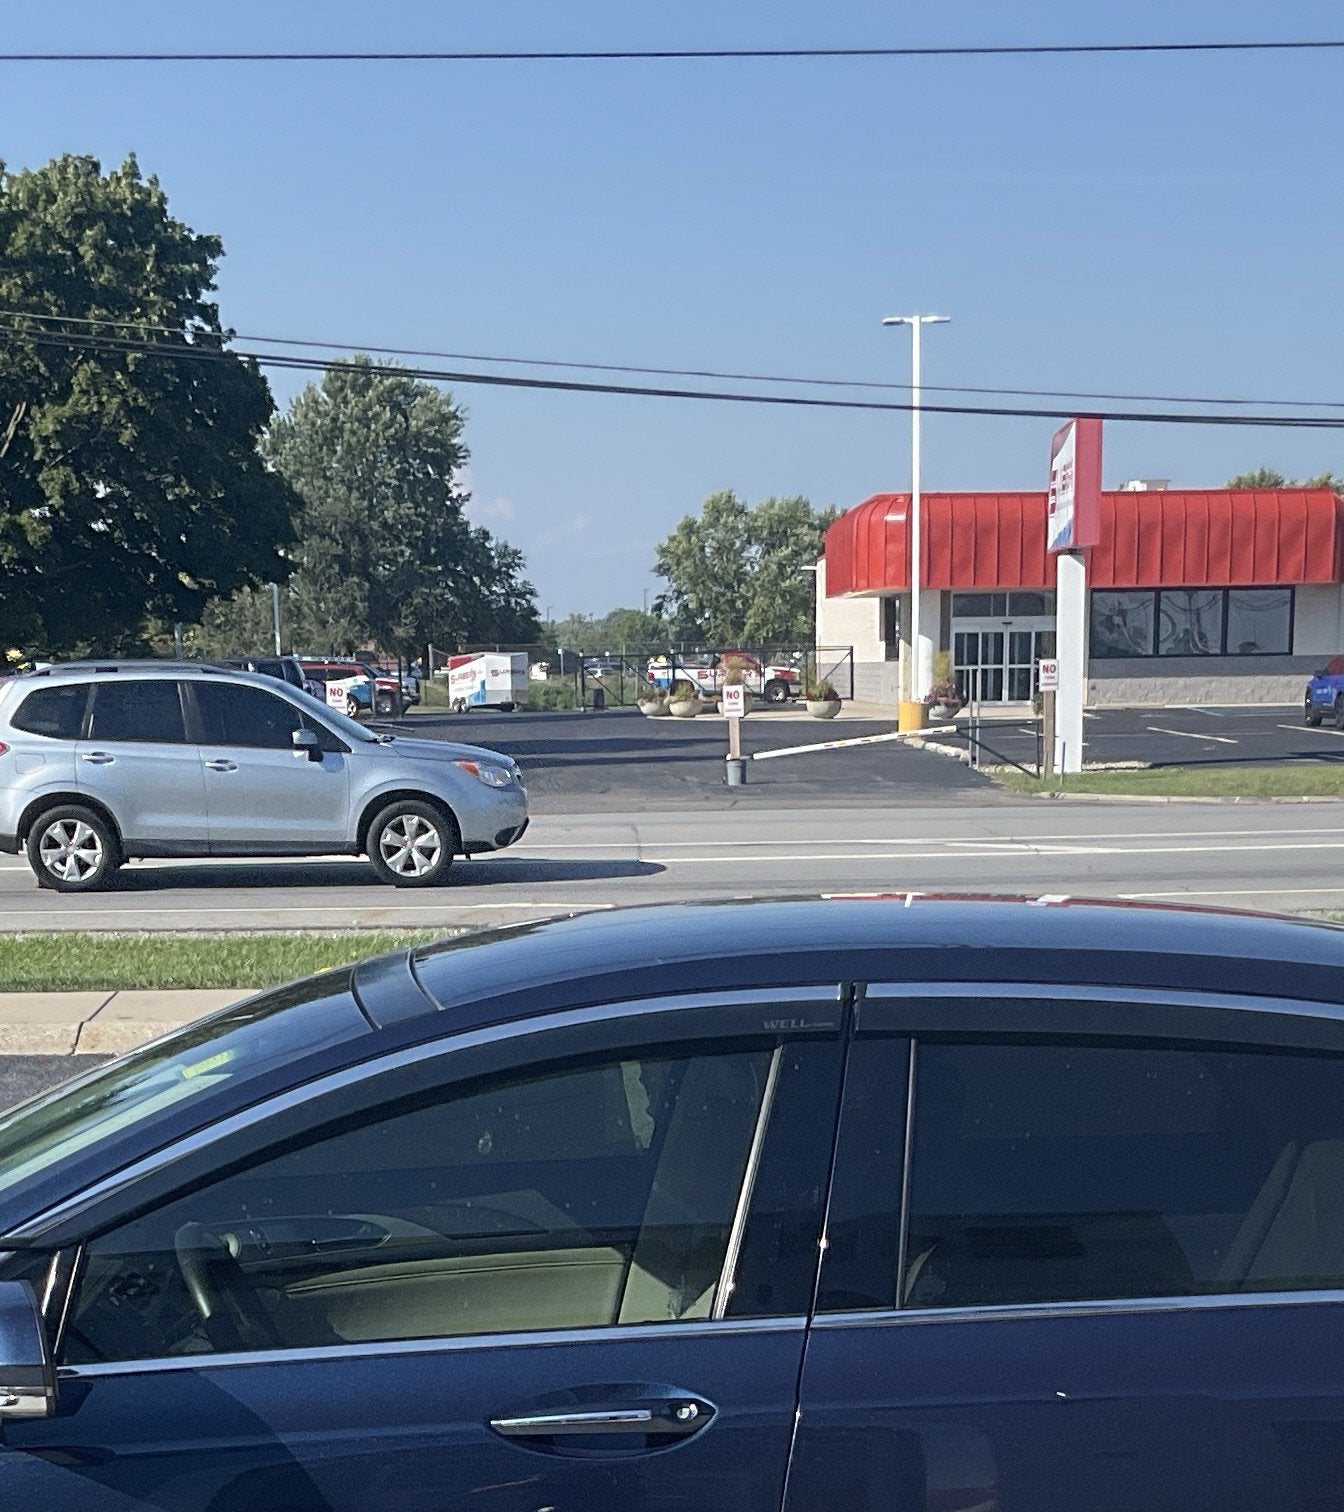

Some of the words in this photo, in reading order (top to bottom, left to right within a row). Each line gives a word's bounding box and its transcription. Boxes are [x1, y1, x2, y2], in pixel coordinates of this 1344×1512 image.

[1042, 664, 1056, 673] NO
[329, 688, 343, 697] NO
[726, 690, 740, 699] NO
